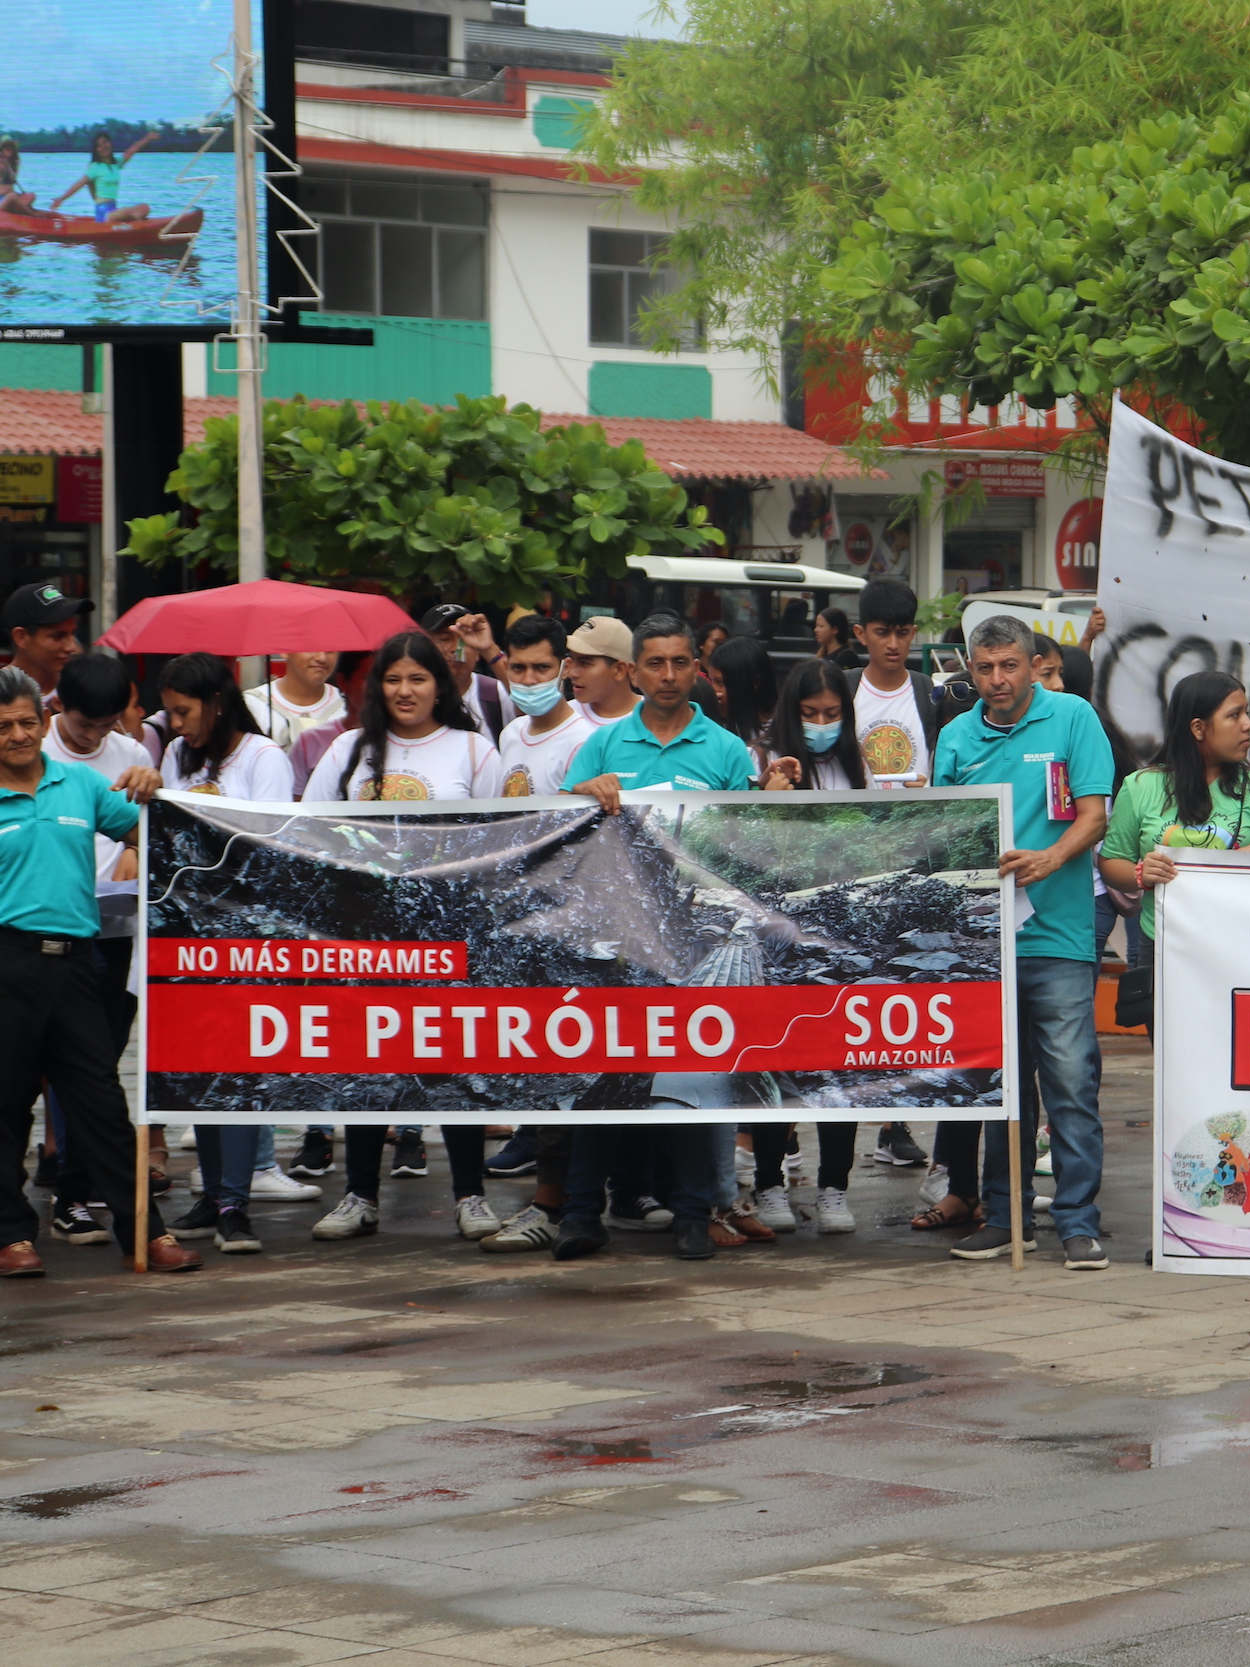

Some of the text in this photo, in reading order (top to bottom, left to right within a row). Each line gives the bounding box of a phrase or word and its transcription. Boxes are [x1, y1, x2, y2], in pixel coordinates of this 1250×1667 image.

[1061, 541, 1097, 567] SIN
[178, 941, 454, 974] NO MÁS DERRAMES
[249, 988, 735, 1058] DE PETRÓLEO
[844, 994, 955, 1046] SOS
[844, 1047, 955, 1066] AMAZONÍA
